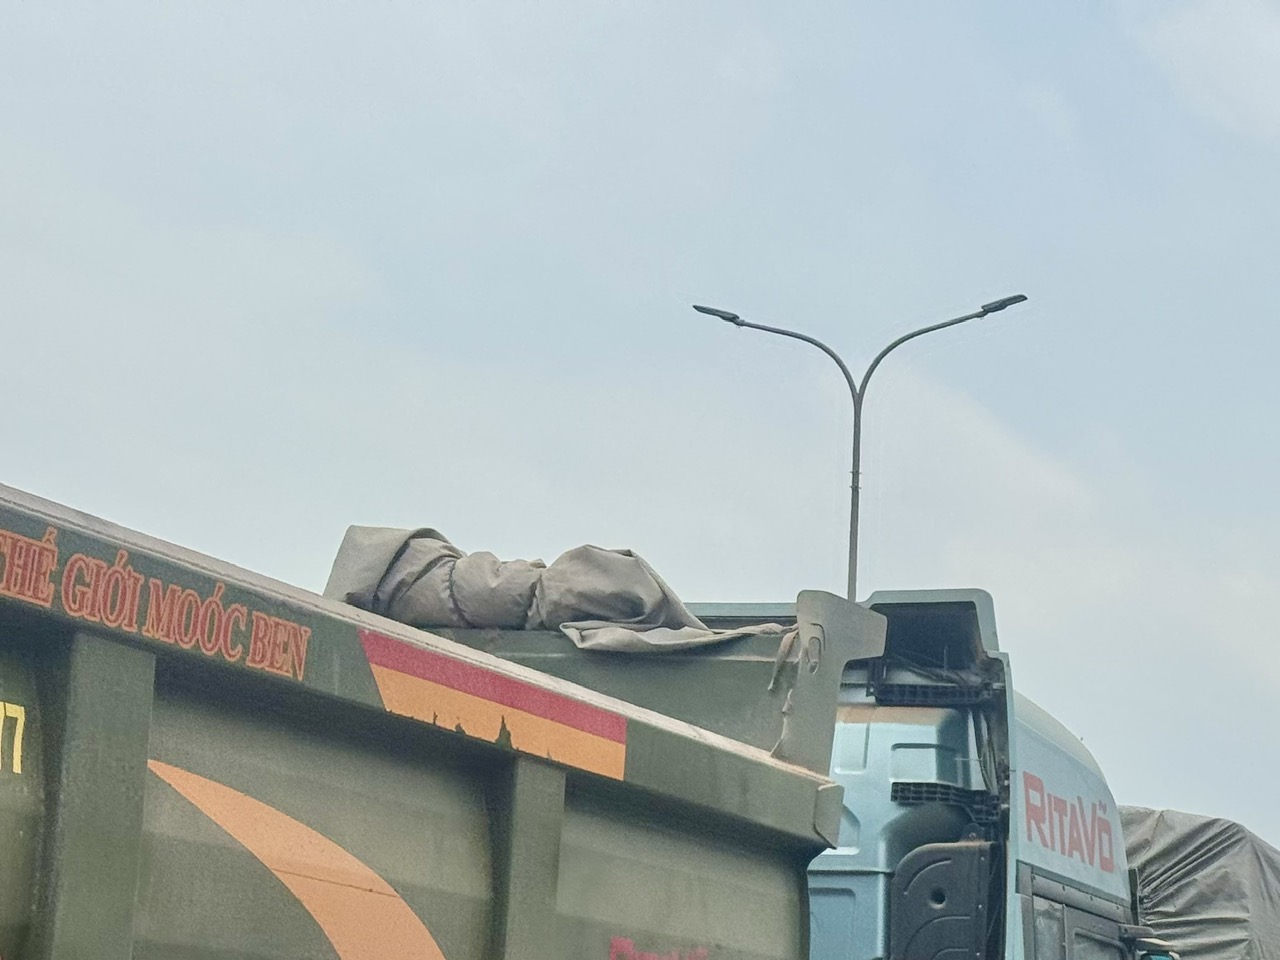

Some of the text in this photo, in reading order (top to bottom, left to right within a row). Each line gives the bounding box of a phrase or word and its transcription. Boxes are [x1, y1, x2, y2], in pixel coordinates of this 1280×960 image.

[61, 550, 144, 634] GIỚI
[142, 579, 248, 662] MOÓC
[246, 611, 311, 682] BEN
